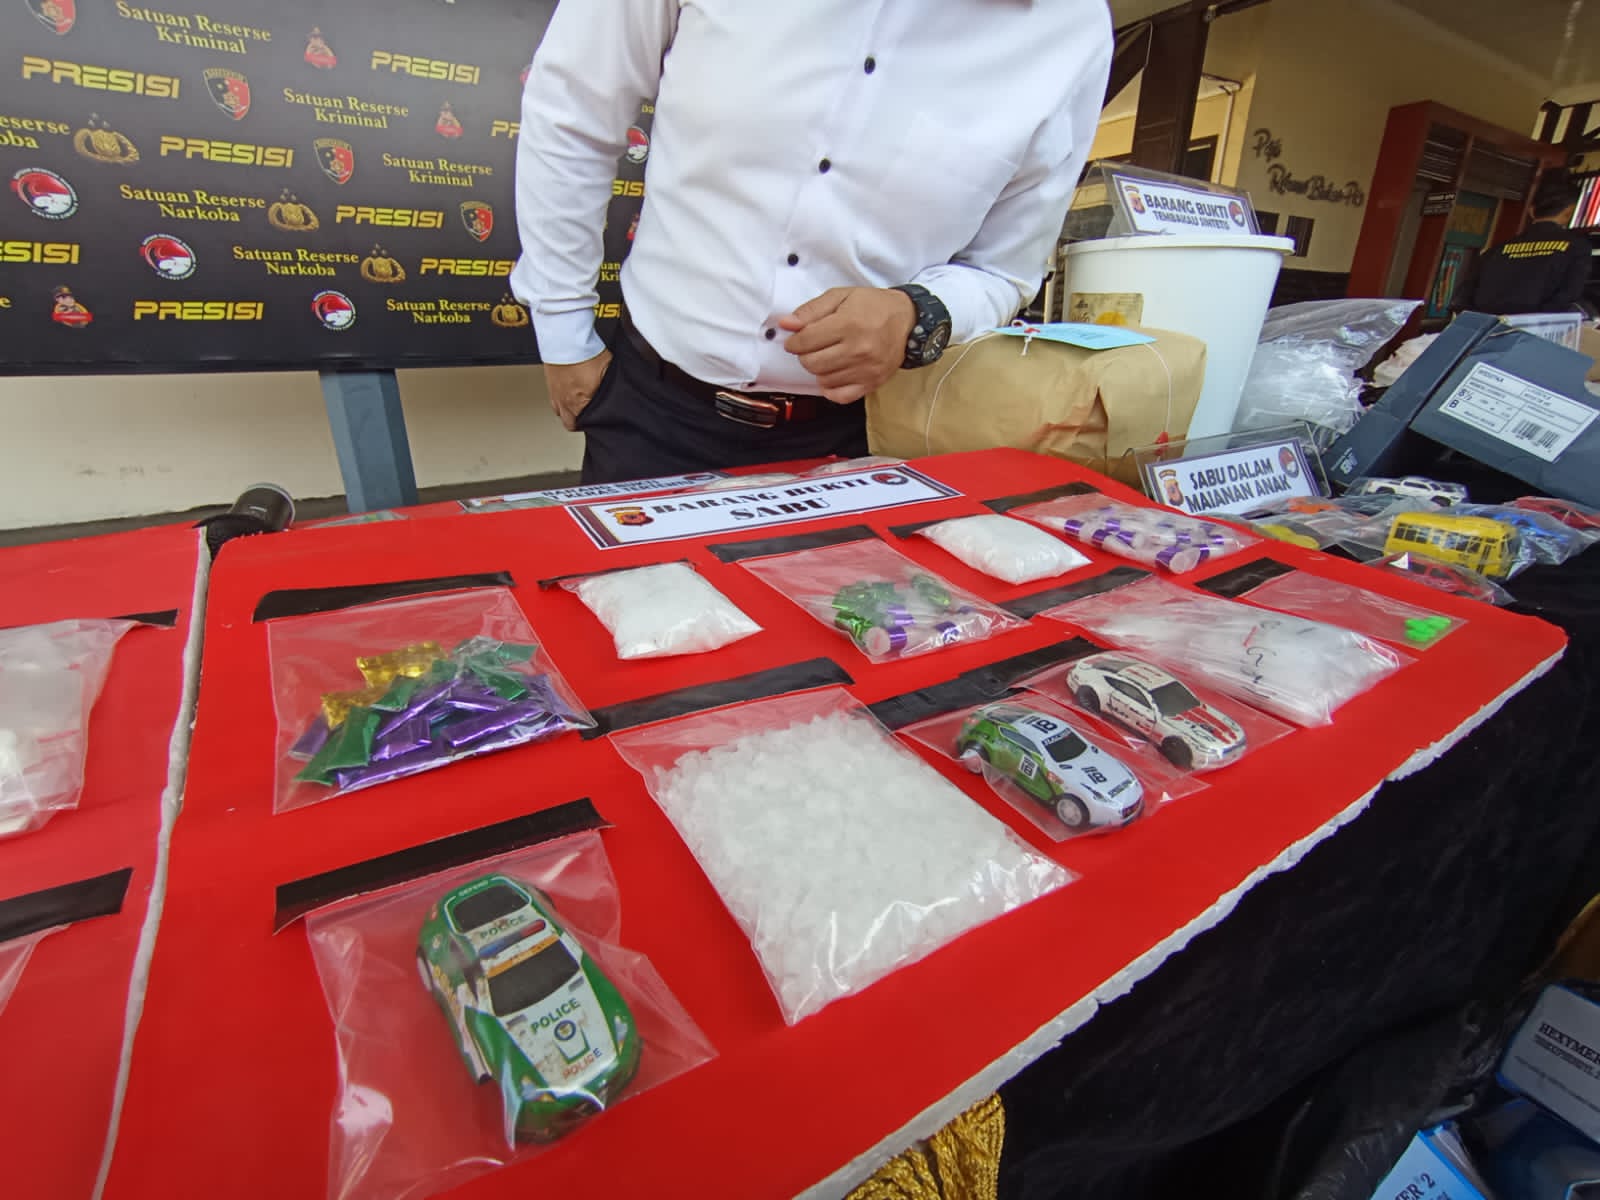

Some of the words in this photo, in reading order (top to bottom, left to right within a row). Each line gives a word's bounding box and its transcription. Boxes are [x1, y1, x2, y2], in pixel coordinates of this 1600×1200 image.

[116, 1, 190, 29] Satuan
[195, 14, 272, 42] Reserse
[155, 25, 247, 54] Kriminal
[22, 55, 181, 99] PRESISI
[371, 50, 480, 85] PRESISI
[283, 87, 344, 109] Satuan
[347, 96, 409, 118] Reserse
[0, 115, 70, 135] eserse
[314, 107, 389, 129] Kriminal
[160, 135, 294, 168] PRESISI
[382, 153, 435, 171] Satuan
[437, 158, 493, 176] Reserse
[408, 169, 473, 187] Kriminal
[119, 184, 190, 204] Satuan
[193, 189, 266, 209] Reserse
[1144, 193, 1195, 214] BARANG
[1195, 202, 1230, 219] BUKTI
[159, 203, 241, 223] Narkoba
[335, 204, 445, 229] PRESISI
[0, 241, 80, 265] SISI
[233, 245, 293, 262] Satuan
[295, 248, 359, 264] Reserse
[266, 261, 337, 277] Narkoba
[133, 301, 264, 321] PRESISI
[386, 298, 435, 312] Satuan
[437, 299, 491, 312] Reserse
[413, 311, 472, 324] Narkoba
[1189, 466, 1225, 491] SABU
[1226, 458, 1274, 482] DALAM
[651, 490, 778, 514] BARANG
[783, 478, 871, 497] BUKTI
[1184, 484, 1254, 513] MAIANAN
[1255, 474, 1292, 498] ANAK
[730, 497, 830, 521] SABU
[530, 997, 581, 1035] POLICE
[562, 1047, 602, 1080] POLICE
